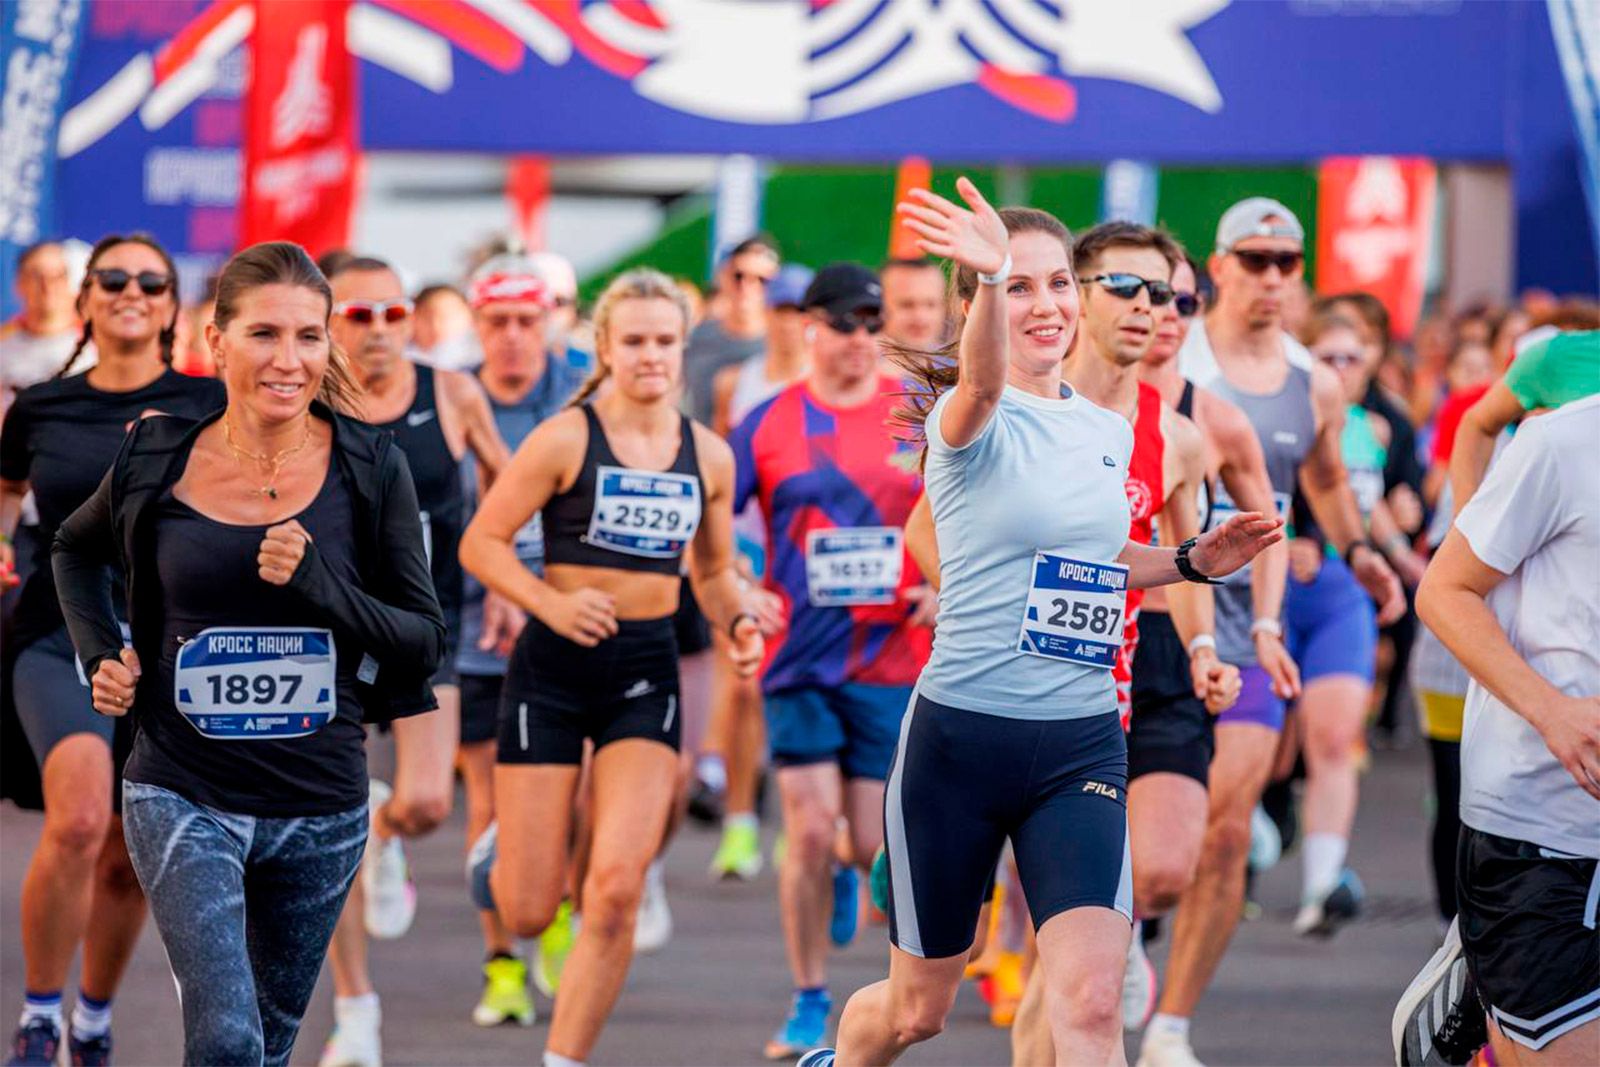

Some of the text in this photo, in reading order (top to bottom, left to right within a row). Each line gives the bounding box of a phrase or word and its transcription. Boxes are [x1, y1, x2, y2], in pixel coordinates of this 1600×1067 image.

[614, 505, 680, 531] 2529
[1059, 561, 1096, 584] КРОСС
[1047, 597, 1122, 636] 2587
[208, 635, 304, 655] КРОСС НАЦИИ
[206, 674, 303, 705] 1897
[1082, 781, 1118, 800] FILA
